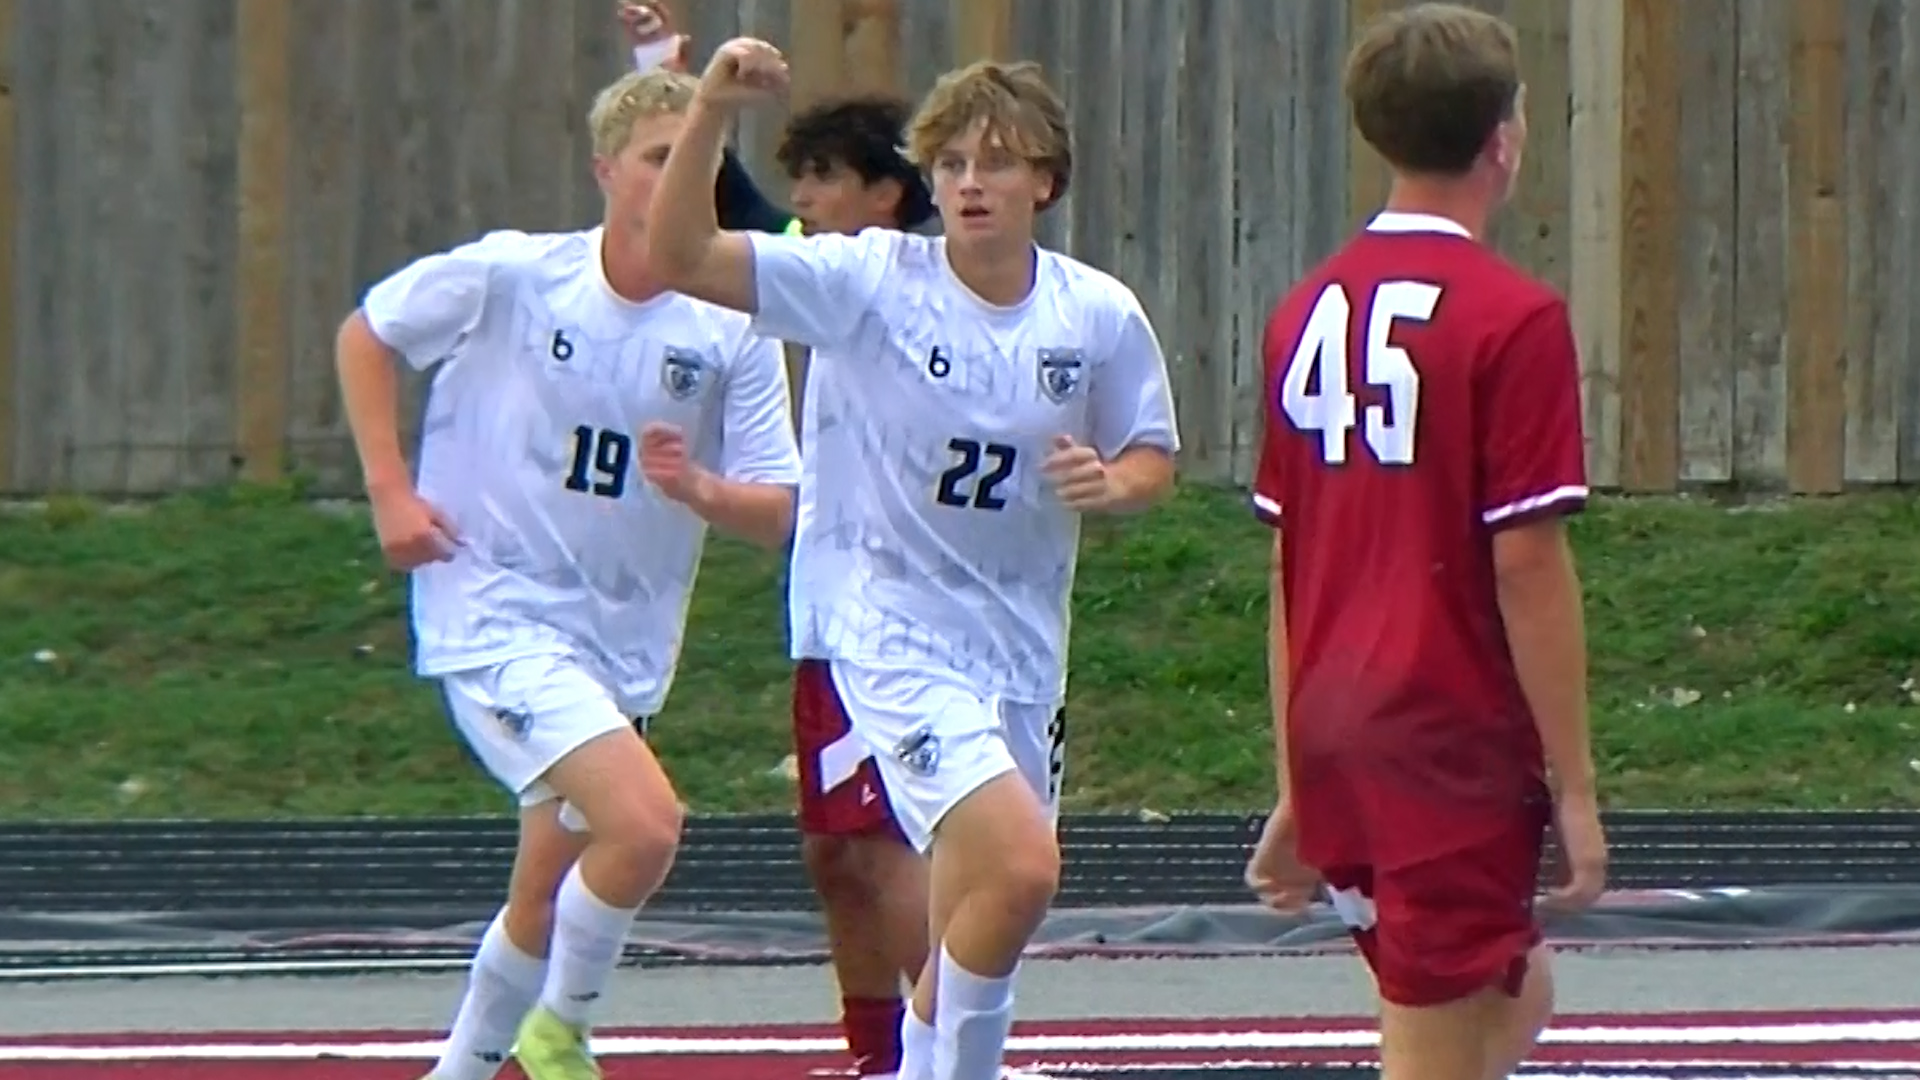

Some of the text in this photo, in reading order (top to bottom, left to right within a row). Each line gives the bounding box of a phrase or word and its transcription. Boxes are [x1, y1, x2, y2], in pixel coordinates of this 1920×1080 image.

[1280, 280, 1443, 465] 45
[565, 424, 632, 499] 19
[936, 437, 1018, 512] 22
